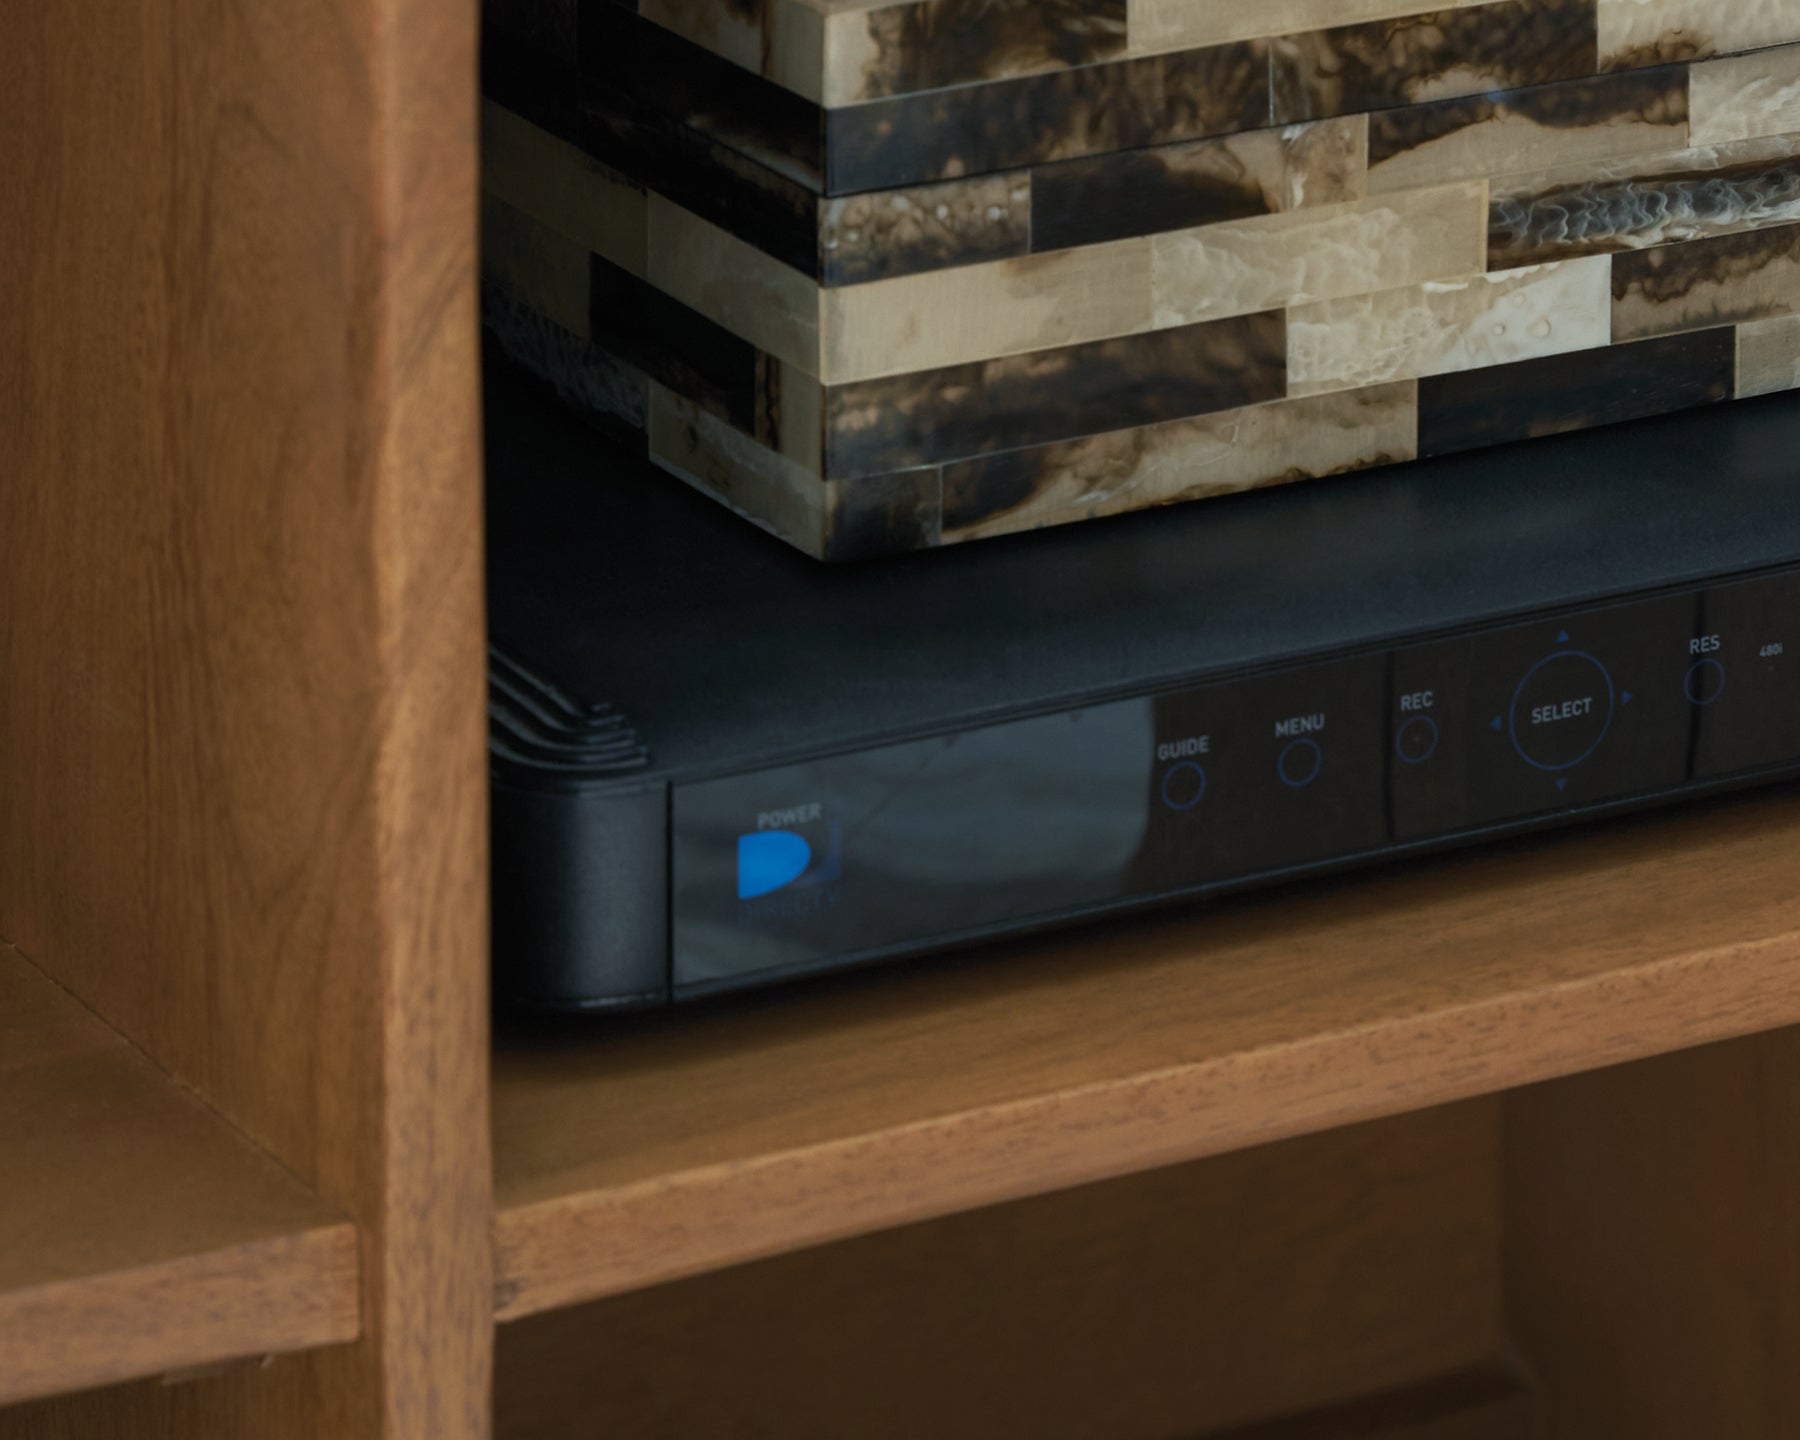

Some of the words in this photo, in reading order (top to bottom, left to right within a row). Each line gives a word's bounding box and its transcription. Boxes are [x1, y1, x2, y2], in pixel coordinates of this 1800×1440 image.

[1689, 634, 1720, 655] RES
[1400, 691, 1434, 711] REC
[1531, 698, 1593, 725] SELECT
[1275, 713, 1325, 737] MENU
[1157, 735, 1210, 761] GUIDE
[757, 802, 822, 831] POWER
